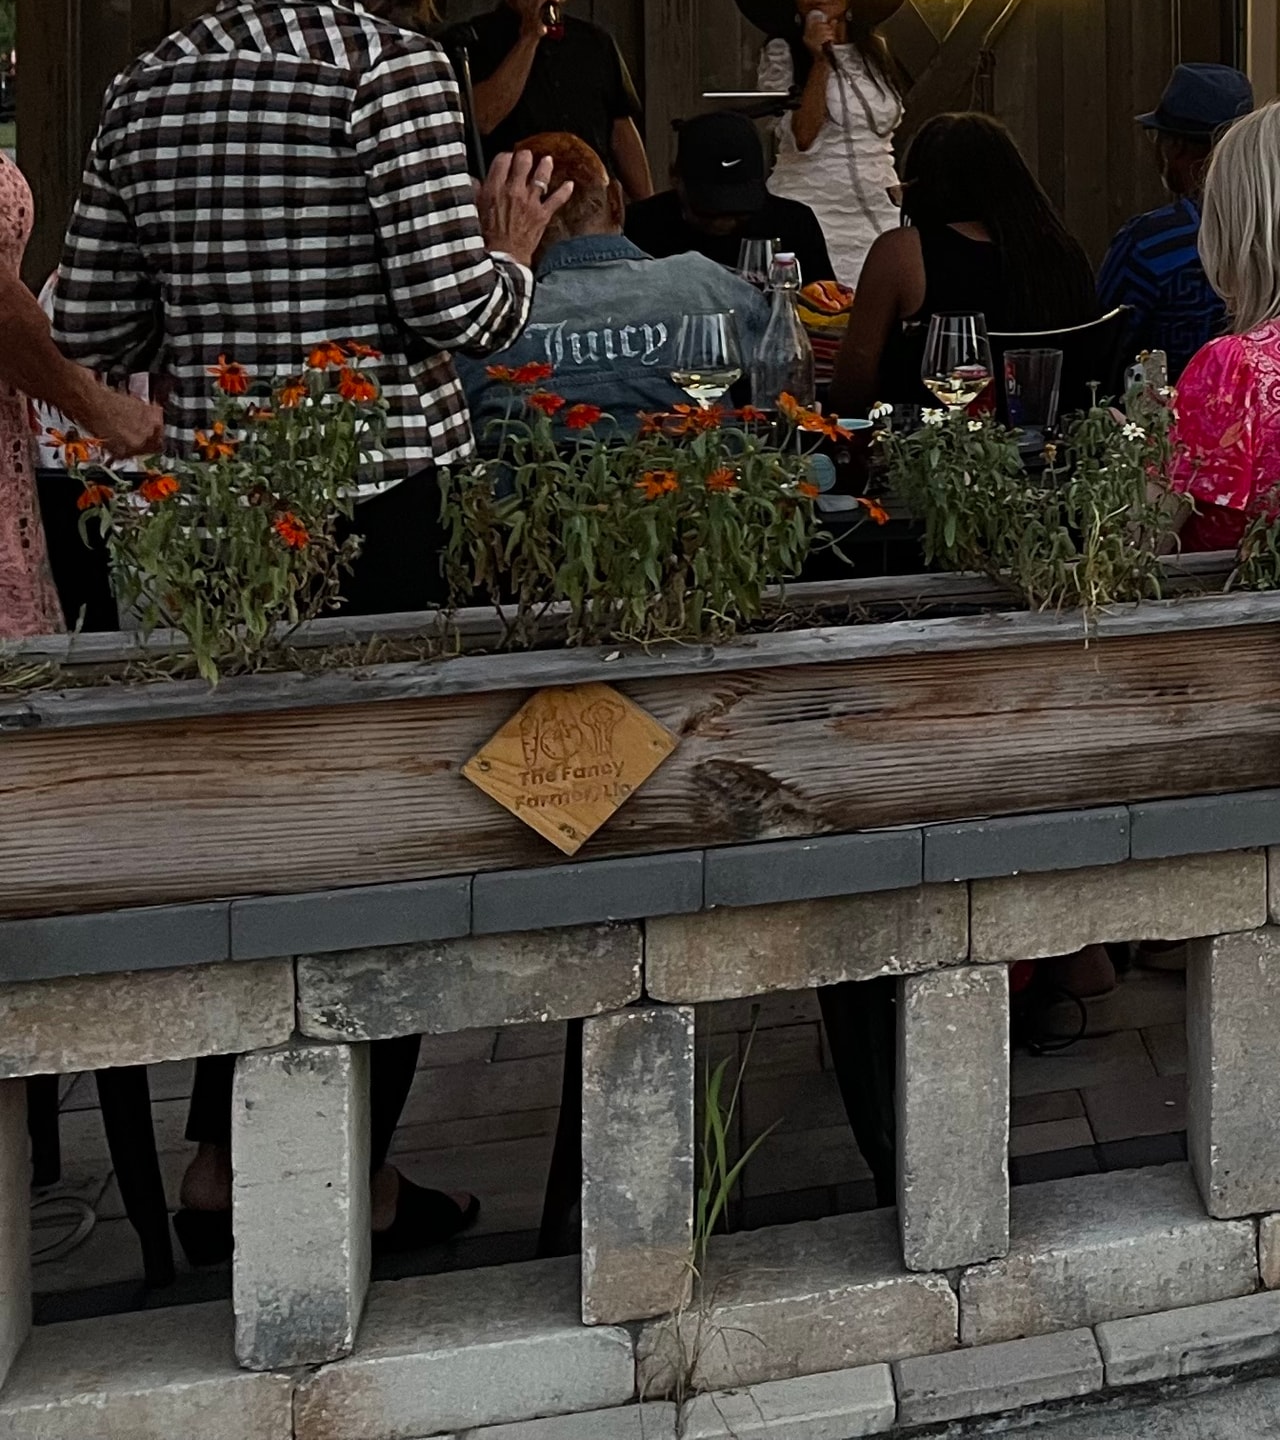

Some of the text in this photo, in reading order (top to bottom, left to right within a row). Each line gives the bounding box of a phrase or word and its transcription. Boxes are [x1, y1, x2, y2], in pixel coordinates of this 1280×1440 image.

[523, 317, 668, 369] Juicy
[518, 760, 624, 786] The Fancy
